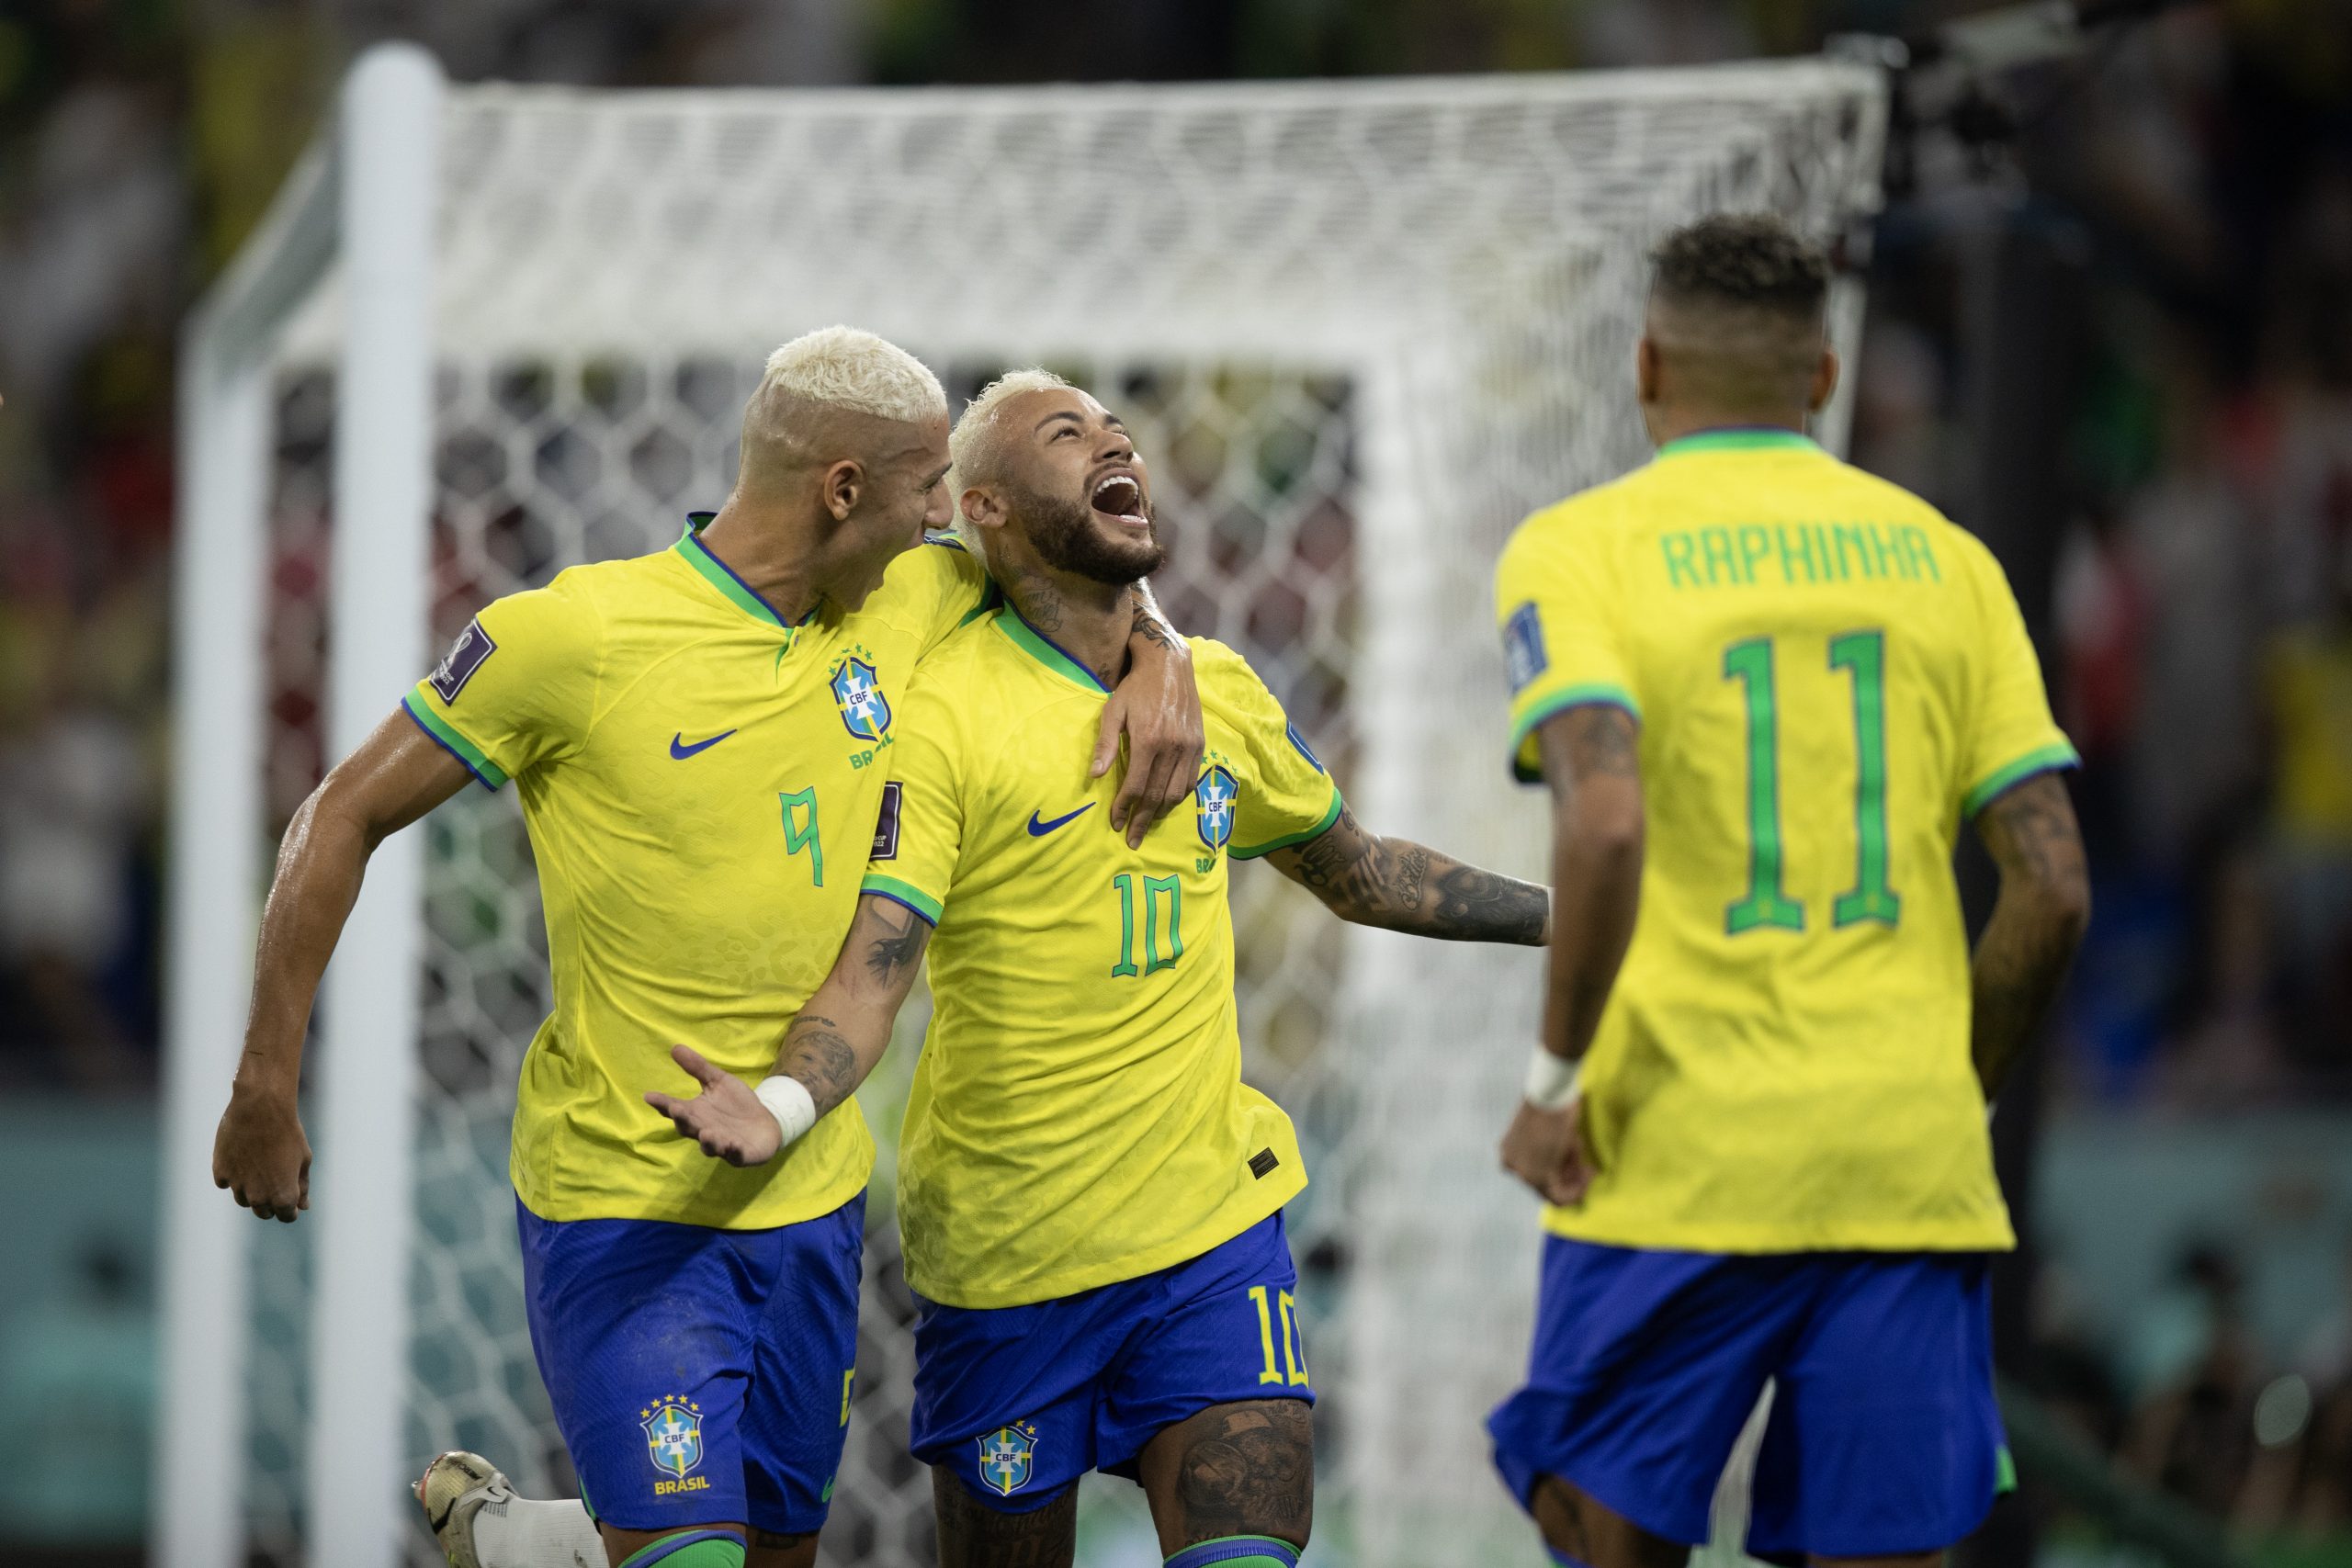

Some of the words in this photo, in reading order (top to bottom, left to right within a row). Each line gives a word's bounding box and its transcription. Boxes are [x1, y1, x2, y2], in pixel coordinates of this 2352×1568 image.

[1660, 521, 1941, 589] RAPHINHA
[849, 691, 868, 705] CBF
[849, 732, 894, 770] BRIL
[1724, 628, 1900, 937] 11
[1208, 801, 1223, 812] CBF
[778, 785, 823, 887] 9
[1112, 874, 1183, 977] 10
[1249, 1285, 1309, 1388] 10
[664, 1433, 685, 1444] CBF
[995, 1453, 1016, 1462] CBF
[654, 1476, 710, 1495] BRASIL
